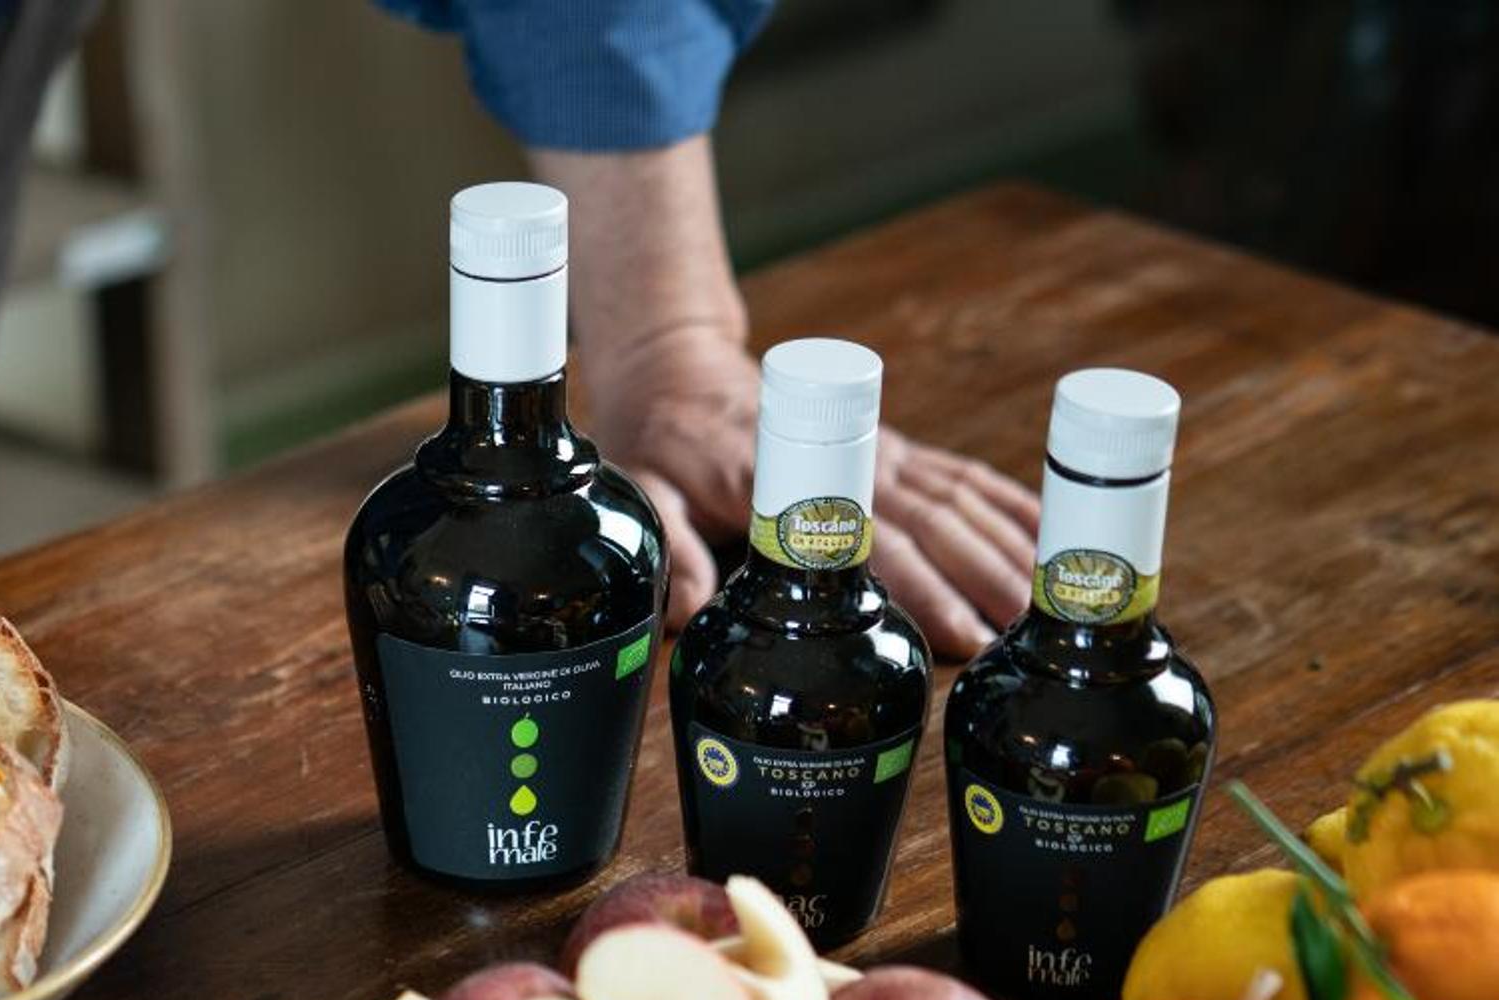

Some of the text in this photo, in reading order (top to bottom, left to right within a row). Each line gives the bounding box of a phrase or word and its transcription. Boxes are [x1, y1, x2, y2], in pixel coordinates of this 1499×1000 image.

[477, 672, 511, 681] EXTRA
[513, 669, 558, 681] VERGINE
[503, 680, 552, 690] ITALIANO
[482, 690, 571, 704] BIOLOGICO
[758, 766, 860, 780] TOSCANO
[770, 787, 845, 798] BIOLOGICO
[1024, 816, 1130, 834] TOSCANO
[1035, 838, 1113, 852] BIOLOGICO
